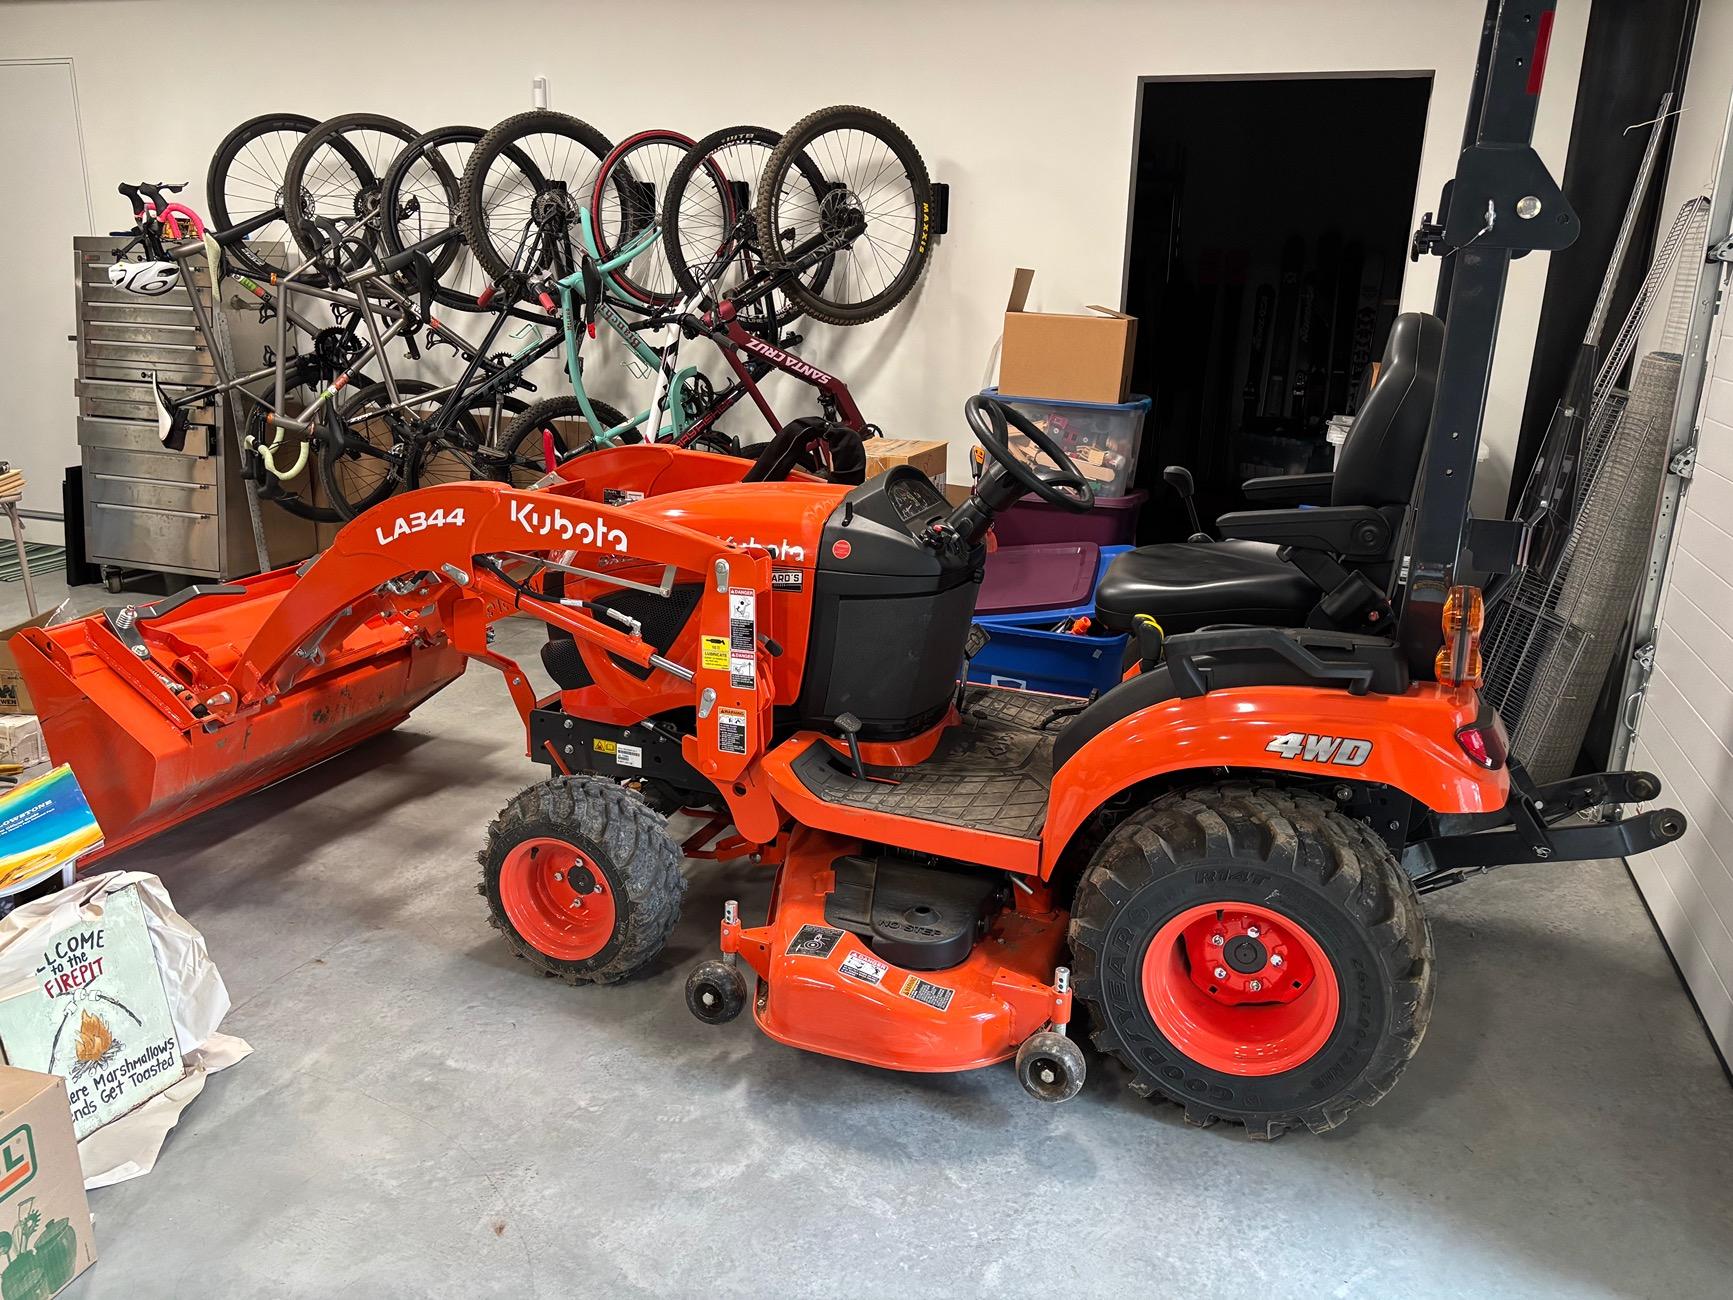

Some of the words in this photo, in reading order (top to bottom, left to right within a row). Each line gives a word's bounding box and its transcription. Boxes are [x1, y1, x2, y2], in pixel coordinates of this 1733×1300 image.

[918, 202, 930, 254] MAXXIS
[599, 303, 641, 348] Bianchi
[745, 337, 785, 364] CRUZ
[375, 508, 465, 546] LA344
[510, 500, 628, 552] Kubota
[771, 573, 800, 583] ARD'S
[1265, 732, 1373, 767] 4WD
[878, 919, 901, 930] NO
[903, 924, 943, 937] STEP
[37, 929, 104, 973] LCOME
[51, 963, 64, 976] to
[66, 951, 88, 969] the
[44, 957, 103, 999] FIREPIT
[1107, 926, 1234, 1099] GOODYEAR
[69, 1085, 90, 1106] ere
[93, 1037, 175, 1088] Marshmallows
[71, 1099, 98, 1124] nds
[100, 1080, 125, 1104] Get
[129, 1052, 175, 1087] Toasted
